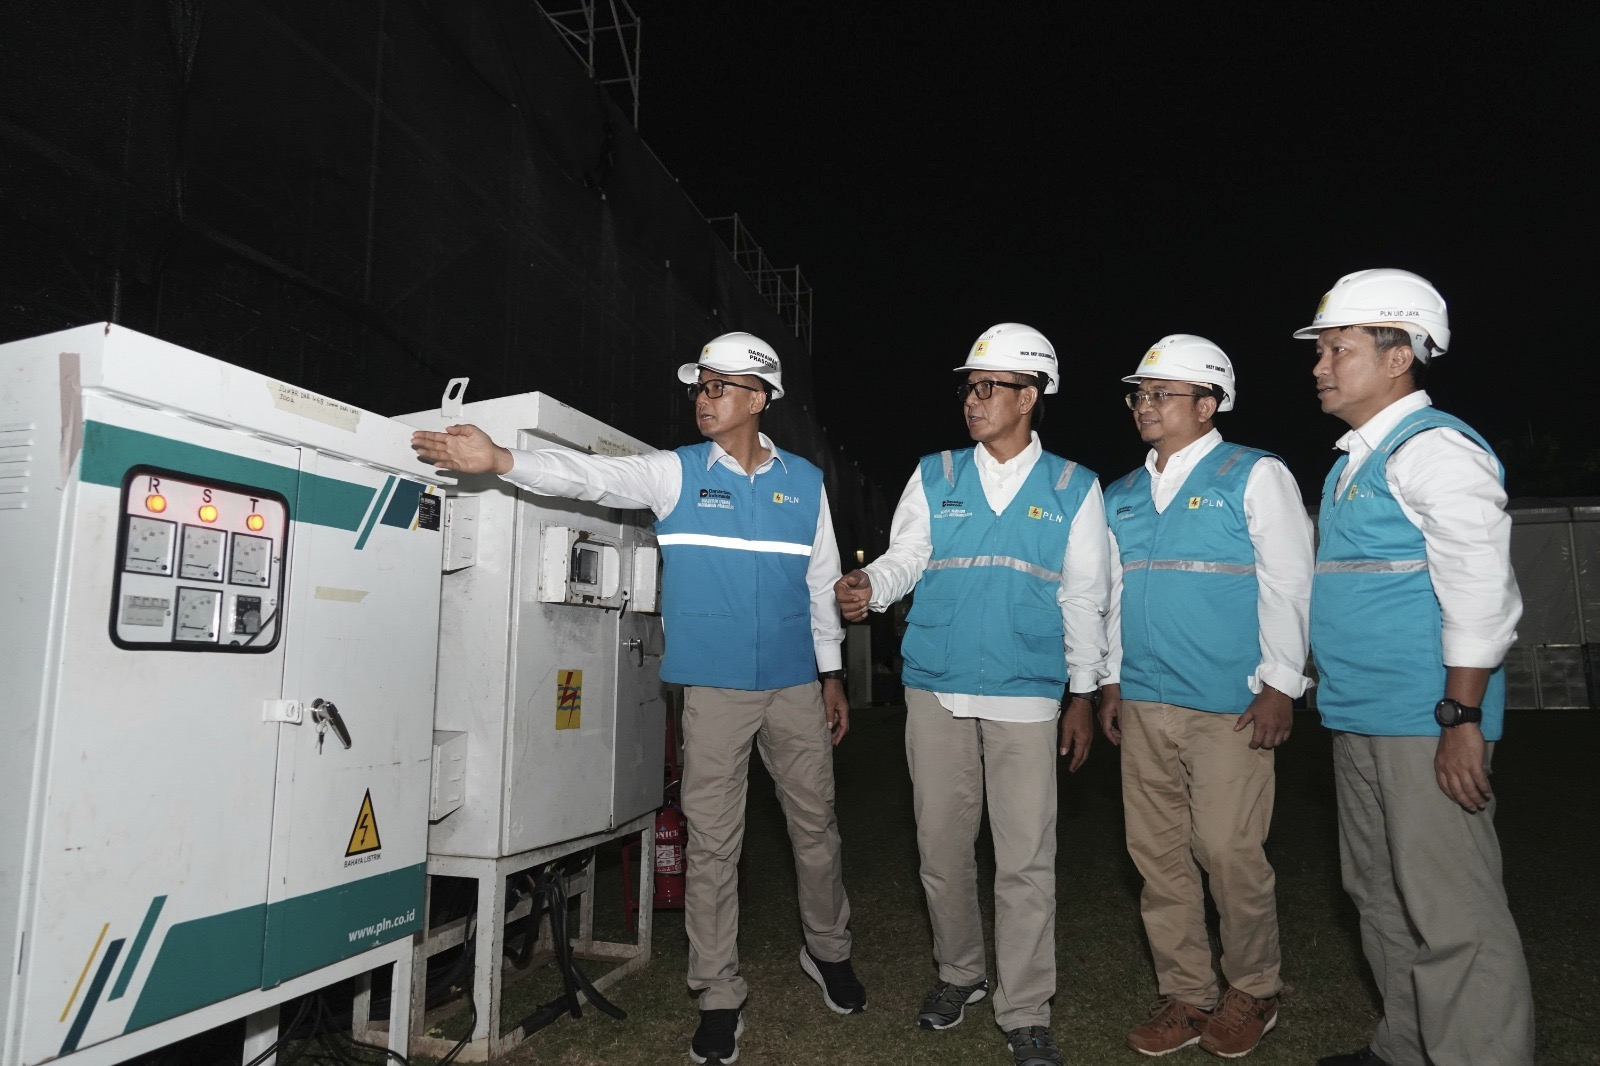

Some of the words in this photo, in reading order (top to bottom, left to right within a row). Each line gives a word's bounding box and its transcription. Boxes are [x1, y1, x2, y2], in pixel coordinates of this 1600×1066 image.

[148, 477, 160, 494] R
[202, 488, 212, 503] S
[784, 495, 799, 504] PLN
[1201, 498, 1224, 508] PLN
[250, 498, 259, 513] T
[1042, 511, 1063, 523] PLN
[343, 856, 364, 869] BAHAYA
[364, 853, 382, 863] LISTRIK
[348, 907, 416, 943] www.pln.co.id
